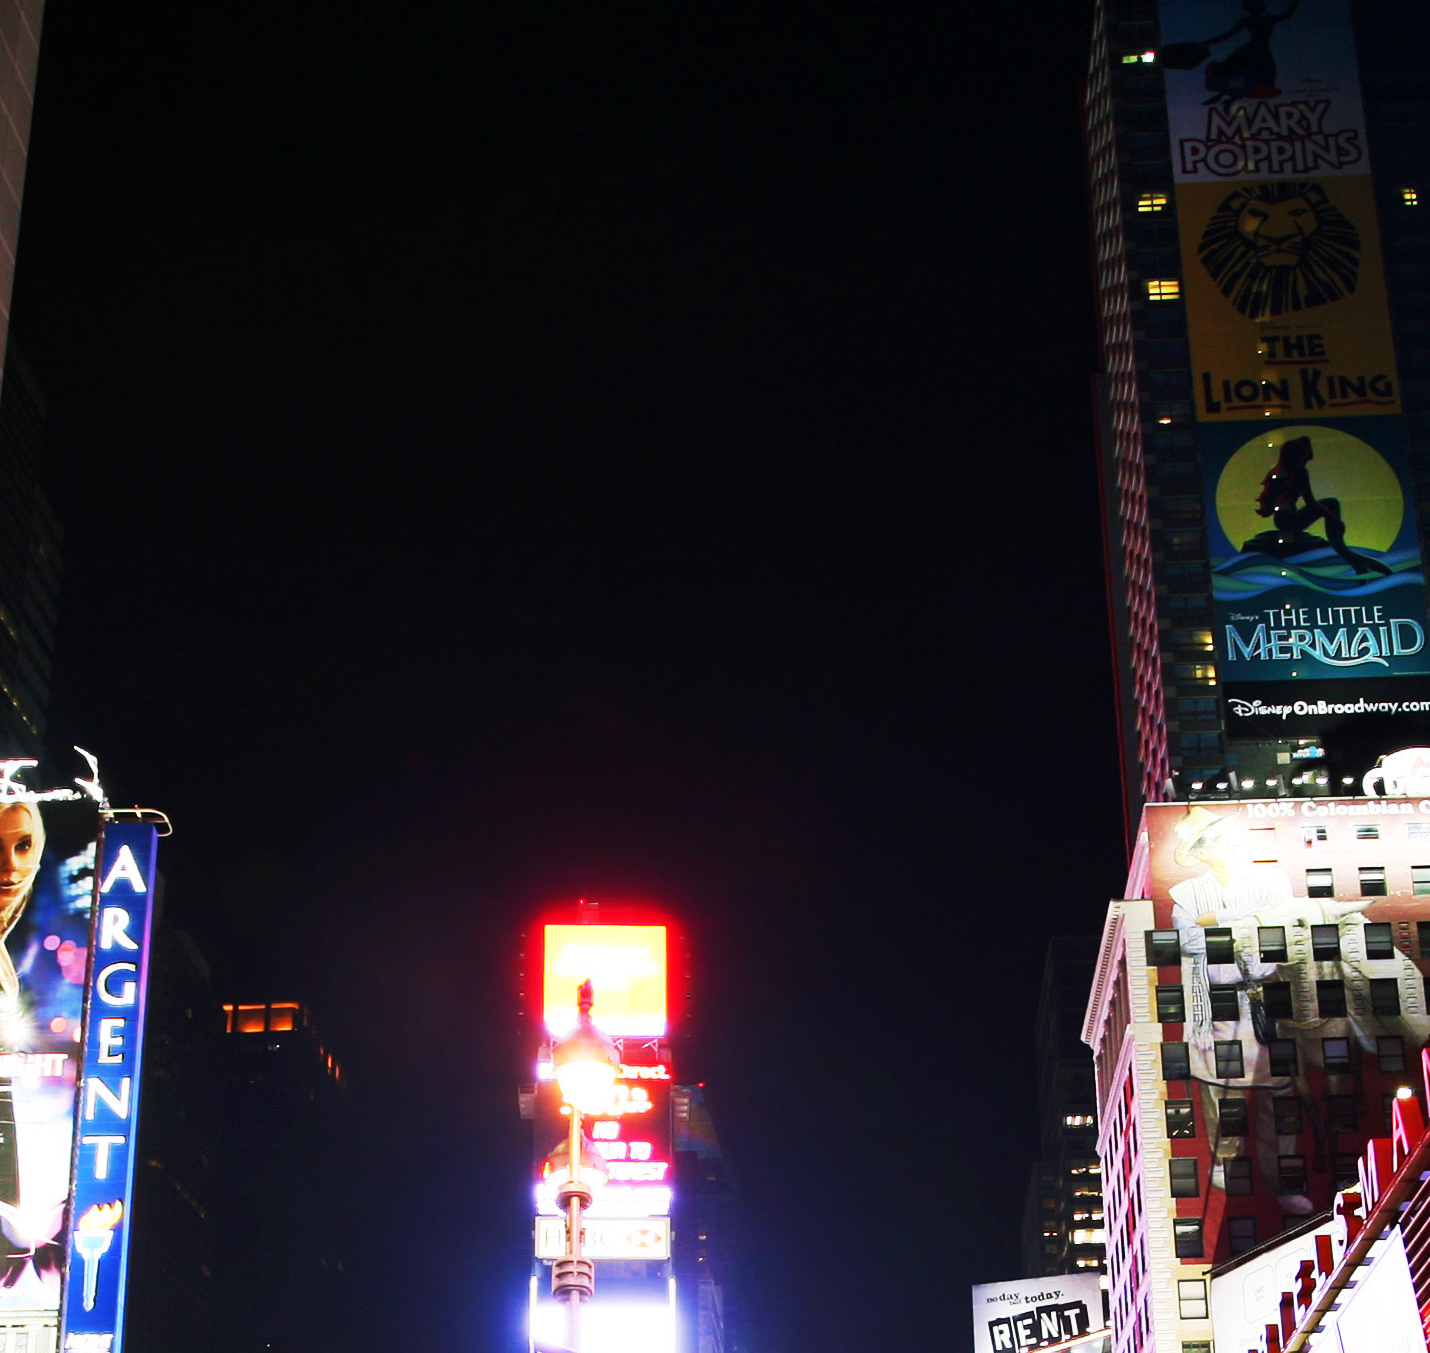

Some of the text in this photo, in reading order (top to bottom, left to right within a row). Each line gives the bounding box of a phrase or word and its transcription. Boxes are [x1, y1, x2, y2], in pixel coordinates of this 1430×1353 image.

[1207, 99, 1331, 143] MARY
[1179, 128, 1363, 177] POPPINS
[1261, 333, 1326, 360] THE
[1202, 367, 1395, 414] LION KING
[1264, 606, 1309, 627] THE
[1315, 604, 1386, 626] LITTLE
[1224, 618, 1425, 668] MERMAID
[1246, 801, 1296, 819] 100%
[1301, 799, 1415, 819] Colombian
[81, 843, 148, 1180] ARGENT
[1024, 1289, 1065, 1304] today.
[991, 1308, 1082, 1352] RENT
